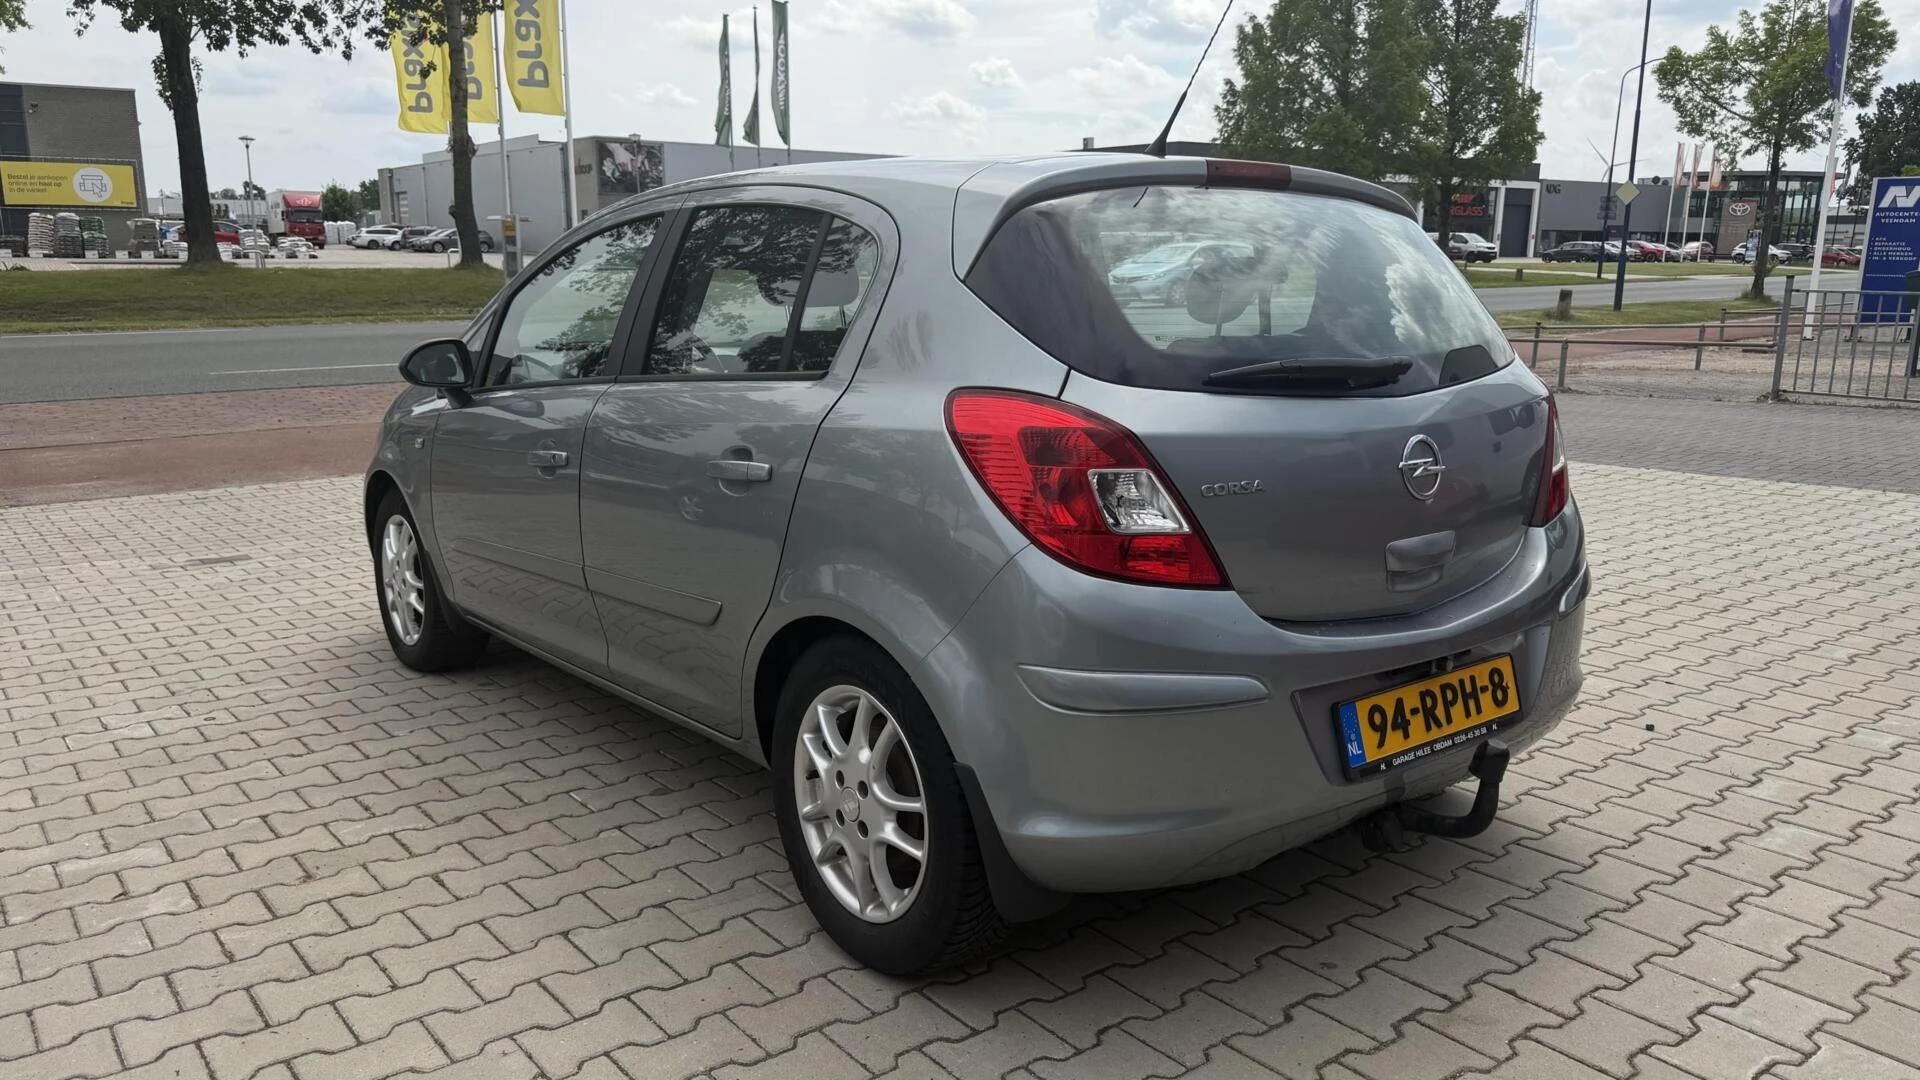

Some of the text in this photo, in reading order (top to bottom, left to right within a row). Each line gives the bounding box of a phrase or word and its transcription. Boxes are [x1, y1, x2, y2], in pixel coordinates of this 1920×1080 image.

[1201, 479, 1266, 498] CORSA
[1368, 667, 1509, 750] 94-RPH-8
[1347, 742, 1363, 758] NL
[1392, 751, 1416, 766] GARAGE
[1433, 739, 1453, 752] OBDAM
